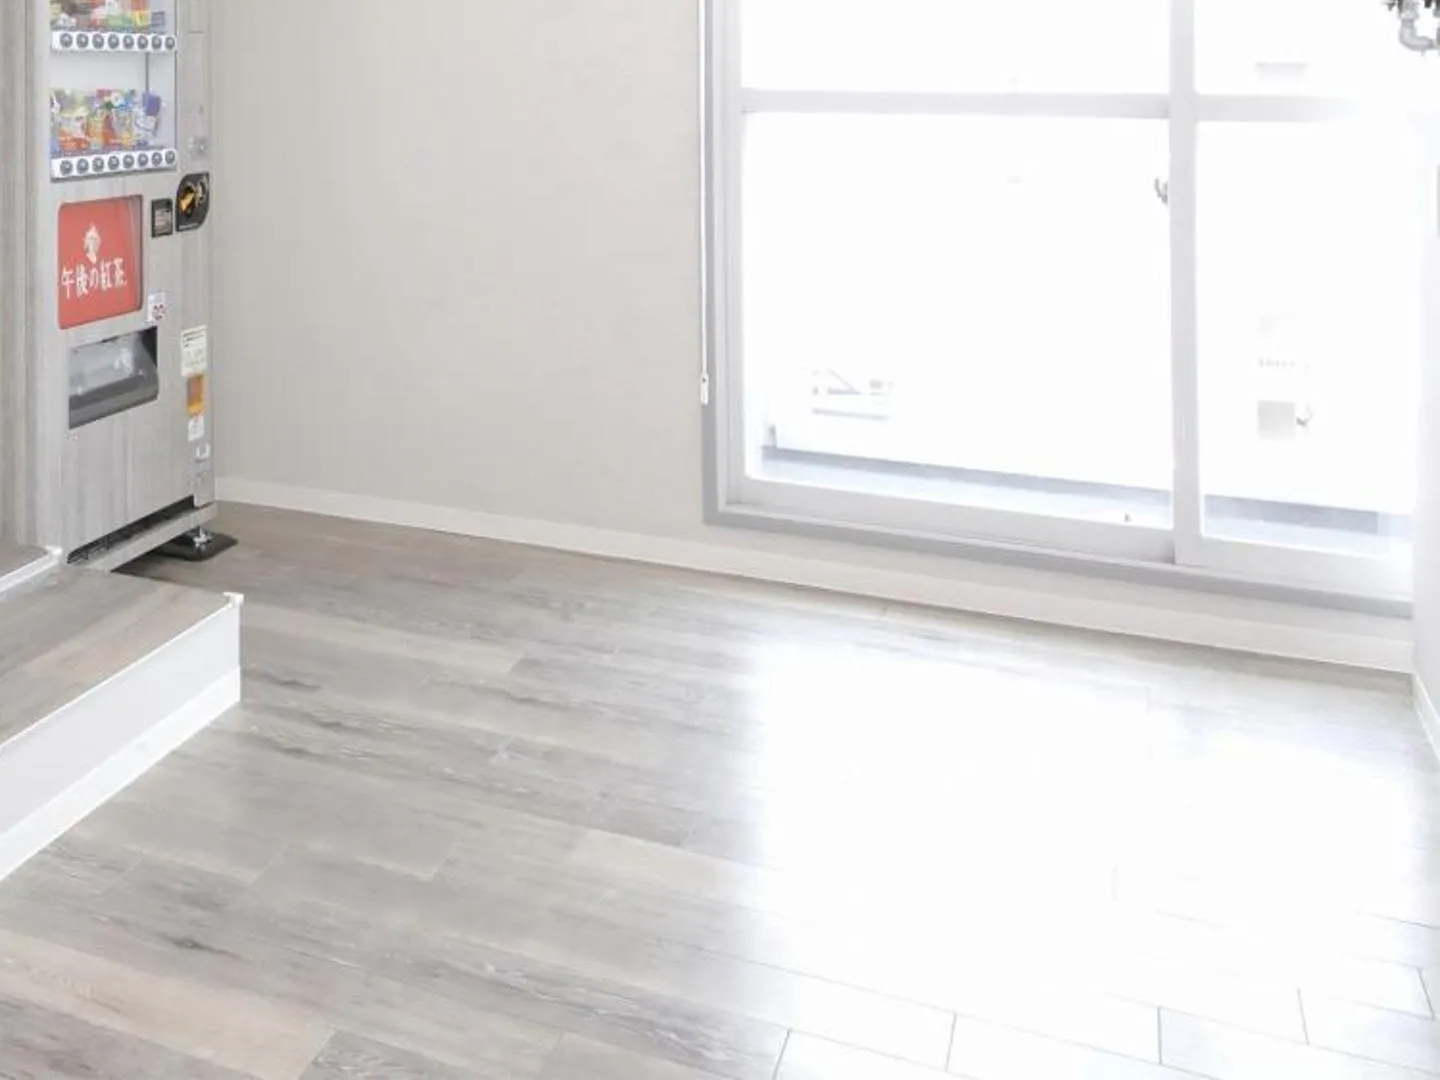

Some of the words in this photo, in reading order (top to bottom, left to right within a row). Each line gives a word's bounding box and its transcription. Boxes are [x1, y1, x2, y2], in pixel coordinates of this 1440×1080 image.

[61, 257, 127, 300] 午後の紅茶
